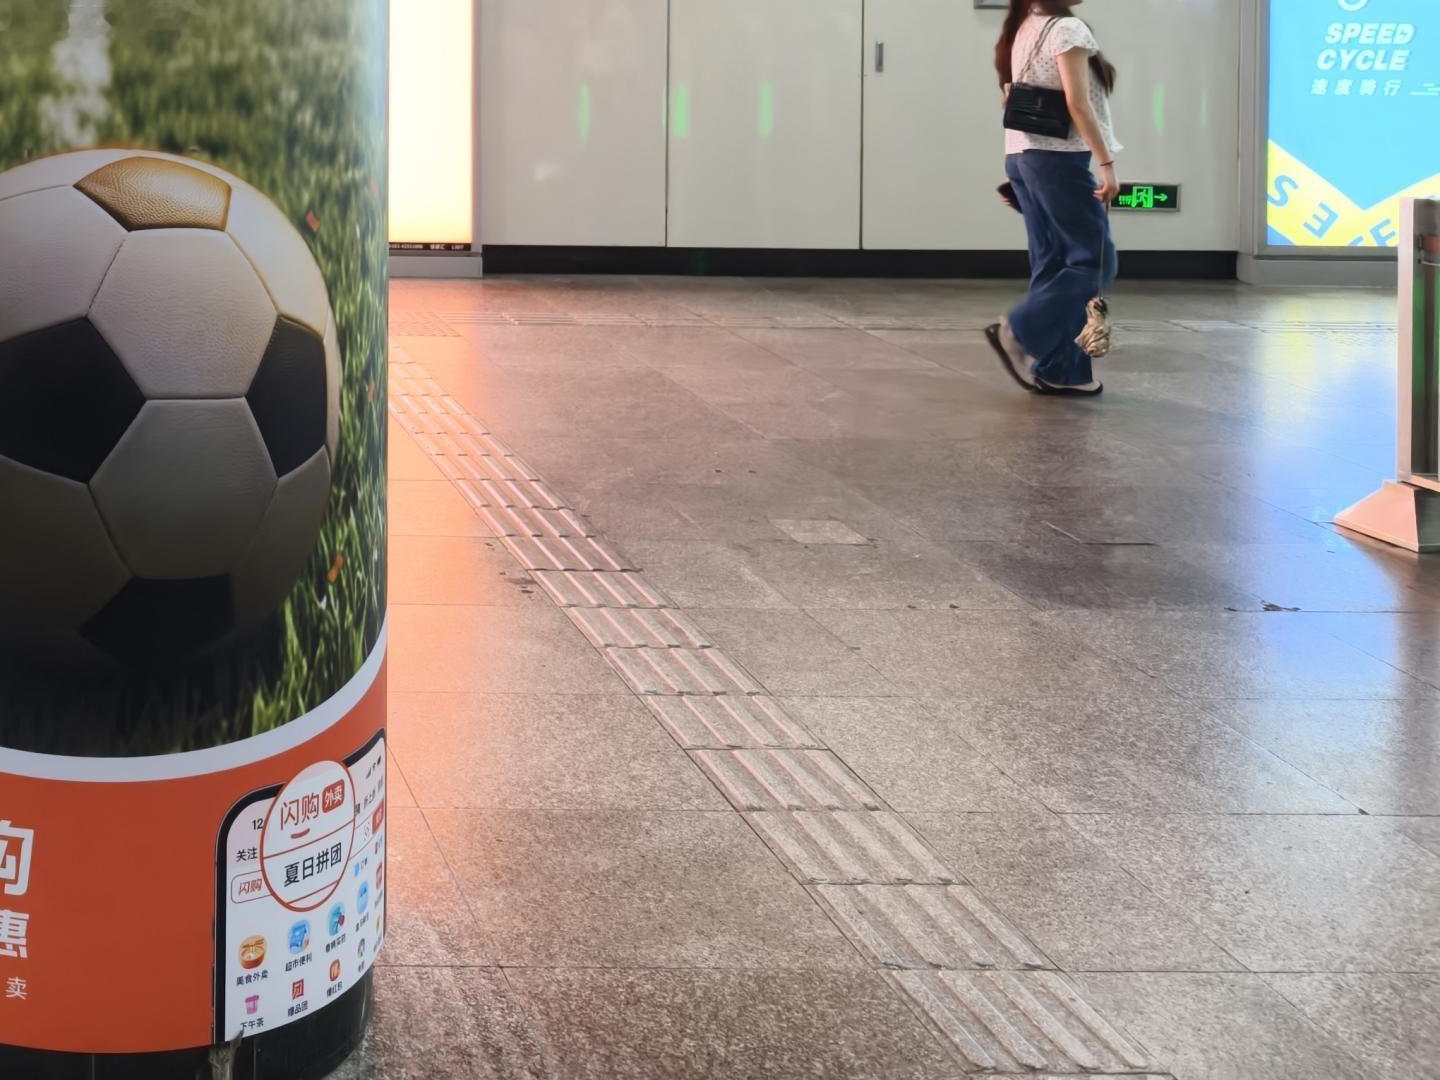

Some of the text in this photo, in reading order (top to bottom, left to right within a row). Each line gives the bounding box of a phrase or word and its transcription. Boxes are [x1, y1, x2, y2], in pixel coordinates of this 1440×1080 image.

[1324, 22, 1415, 45] SPEED
[1316, 48, 1410, 71] CYCLE
[1310, 78, 1402, 96] 速度骑行
[280, 792, 320, 831] 闪购
[324, 784, 343, 807] 外卖
[236, 847, 258, 863] 关注
[284, 842, 342, 888] 夏日拼团
[239, 878, 263, 896] 闪购
[240, 1017, 265, 1030] 下午茶
